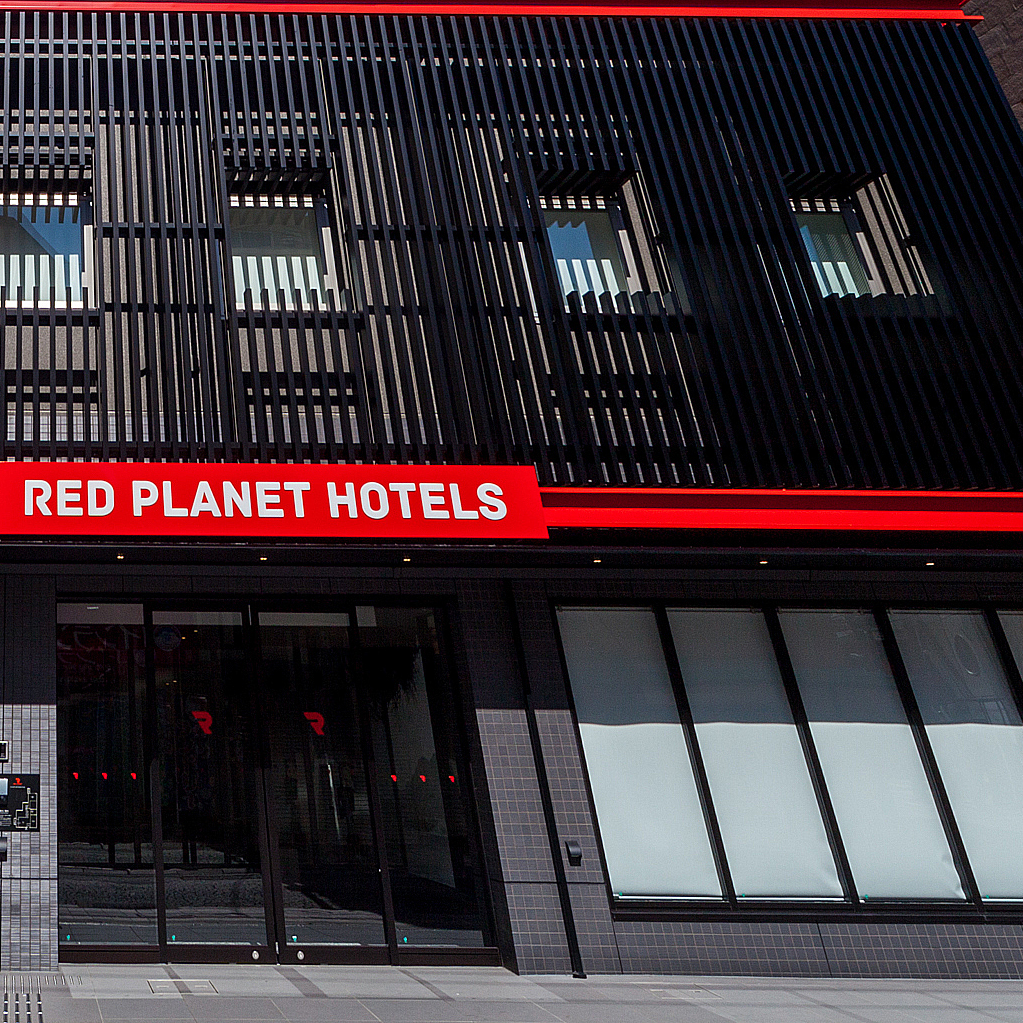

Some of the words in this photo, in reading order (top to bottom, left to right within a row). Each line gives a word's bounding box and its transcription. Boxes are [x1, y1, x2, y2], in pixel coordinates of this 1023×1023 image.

[24, 479, 115, 517] RED
[131, 480, 311, 518] PLANET
[326, 481, 508, 521] HOTELS
